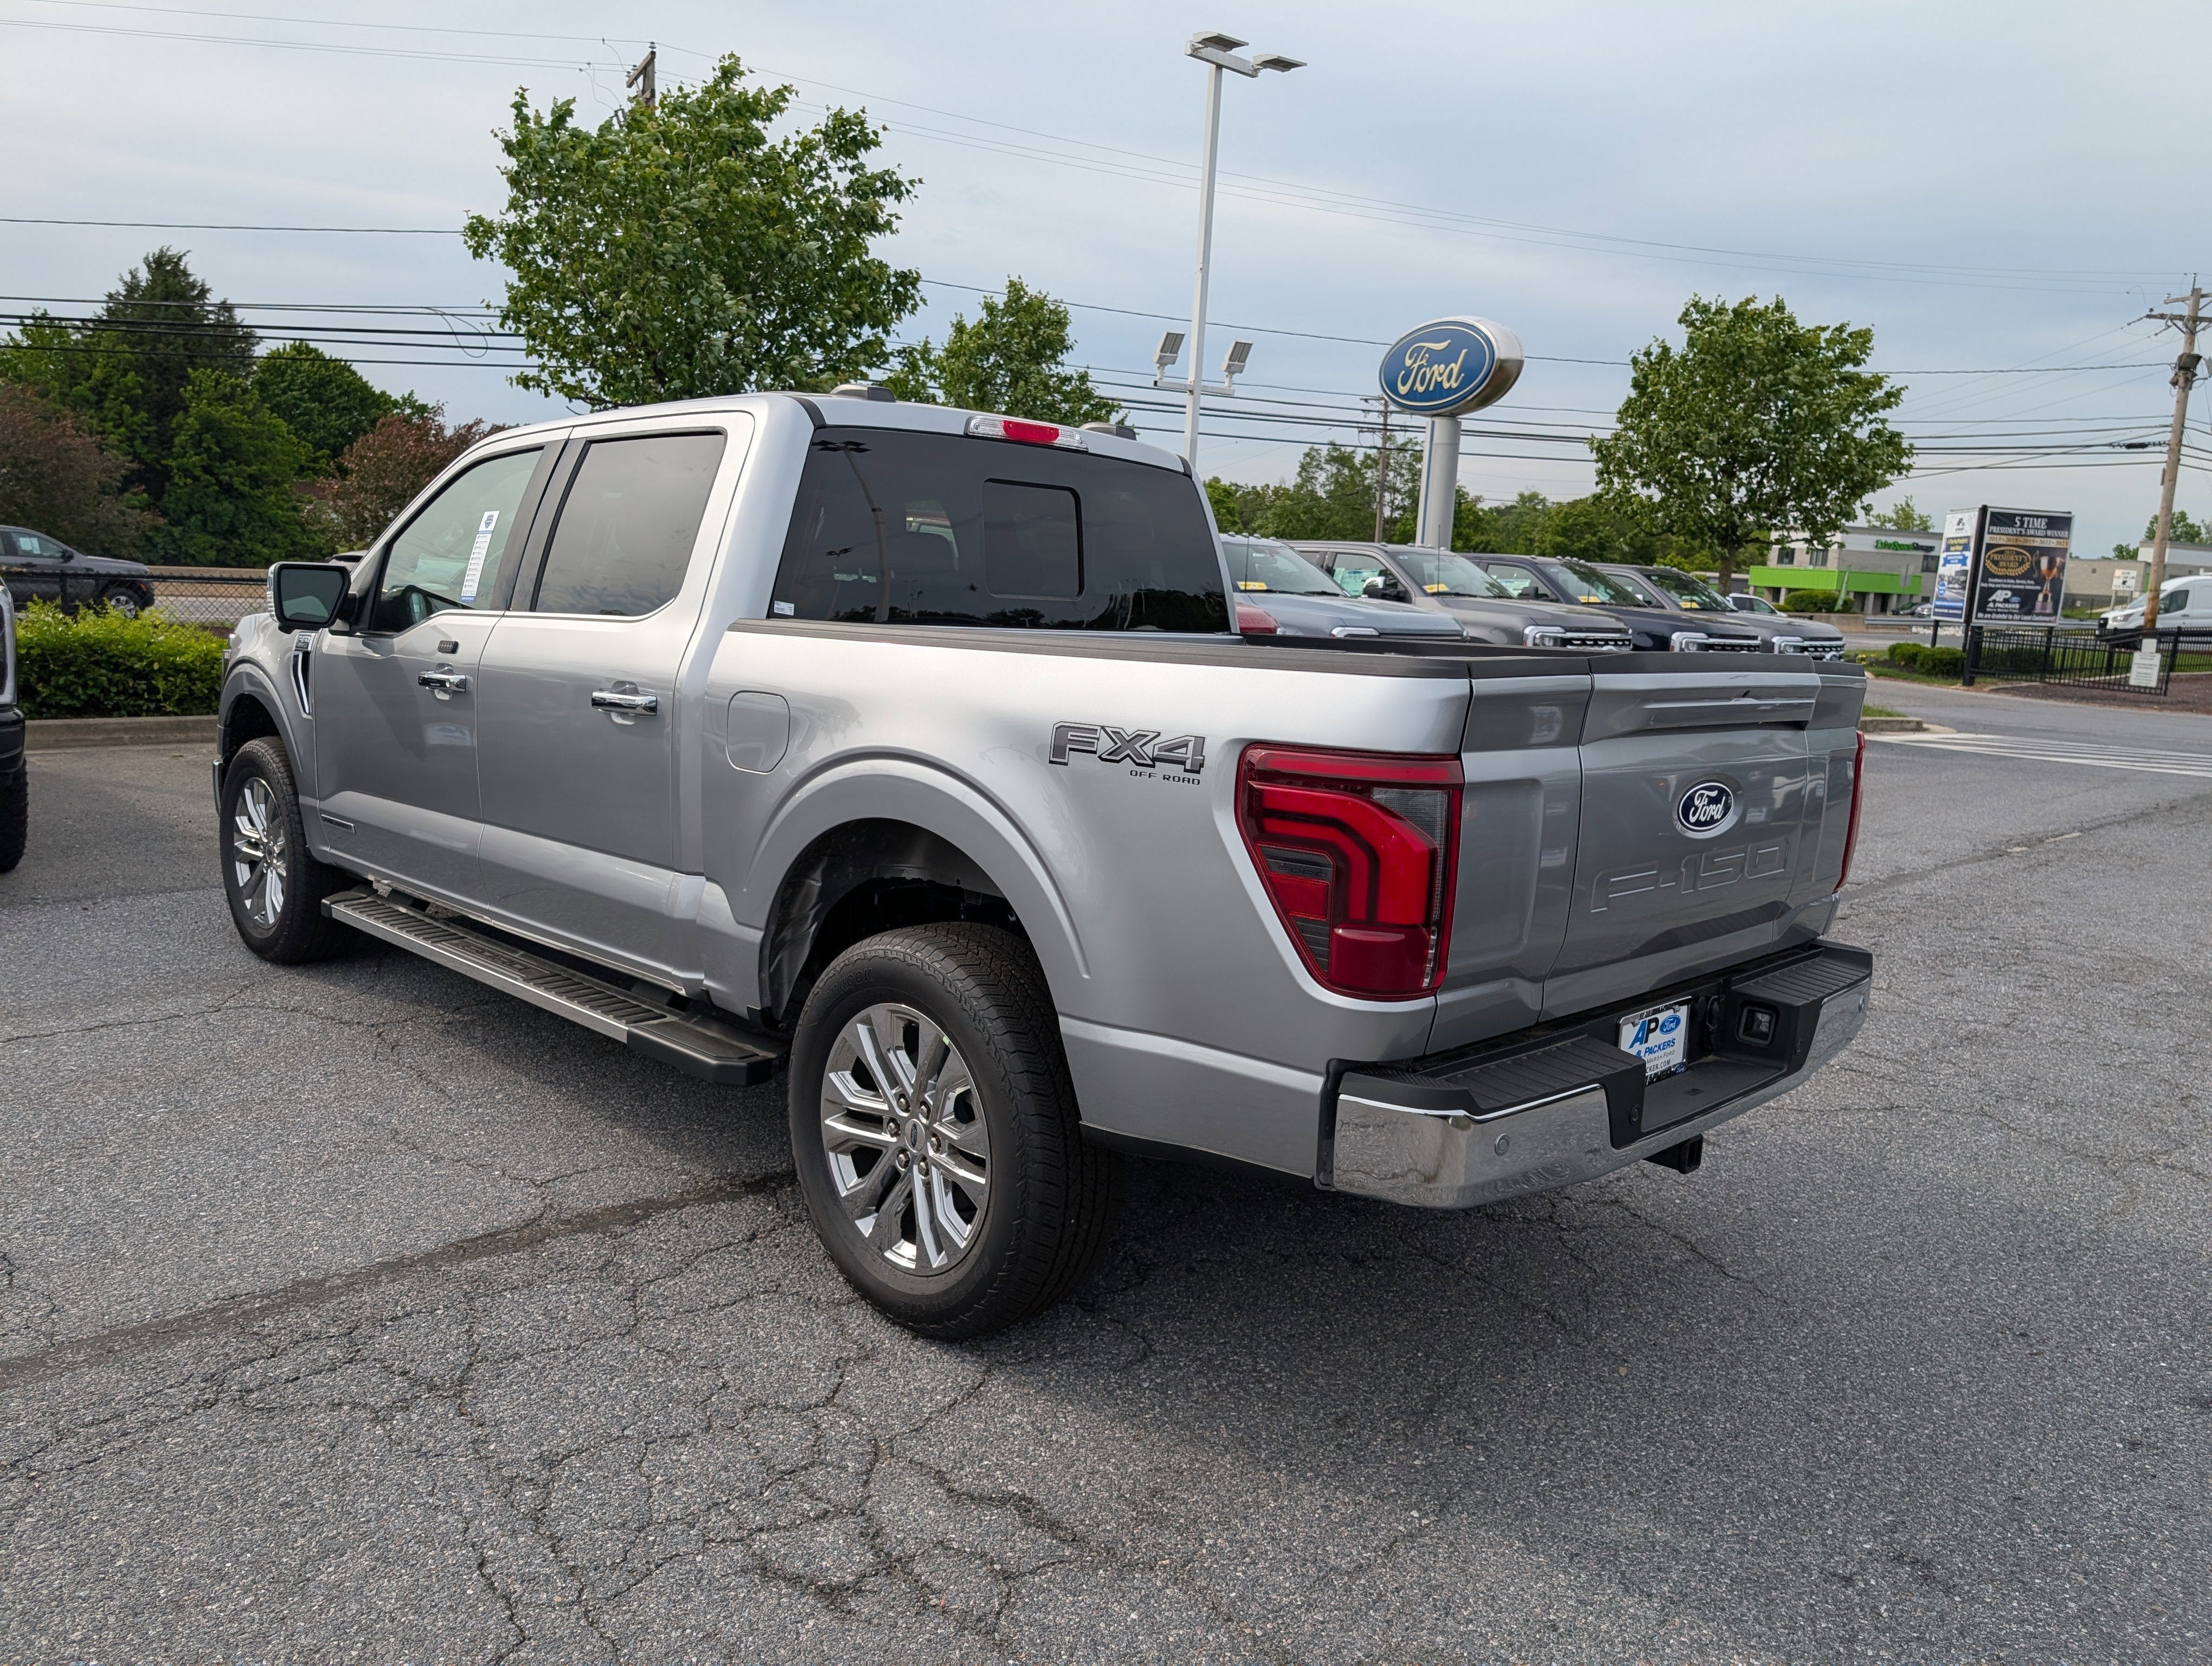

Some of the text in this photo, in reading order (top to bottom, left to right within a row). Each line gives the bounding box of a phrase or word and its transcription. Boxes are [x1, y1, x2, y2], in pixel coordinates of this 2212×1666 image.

[1397, 339, 1468, 395] Ford
[2014, 516, 2048, 529] 5 TIME
[2026, 528, 2046, 536] AWARD
[2047, 530, 2069, 538] WINNER
[1988, 589, 2012, 602] AP
[1049, 721, 1205, 774] FX4
[1130, 770, 1200, 785] OFF ROAD
[1689, 790, 1726, 823] Ford
[1590, 836, 1789, 913] F-150
[1663, 1018, 1676, 1031] Ford
[1629, 1017, 1659, 1049] AP
[1644, 1037, 1676, 1058] PACKER'S
[1646, 1059, 1670, 1073] CKER.COM
[1647, 1055, 1663, 1063] MARSH
